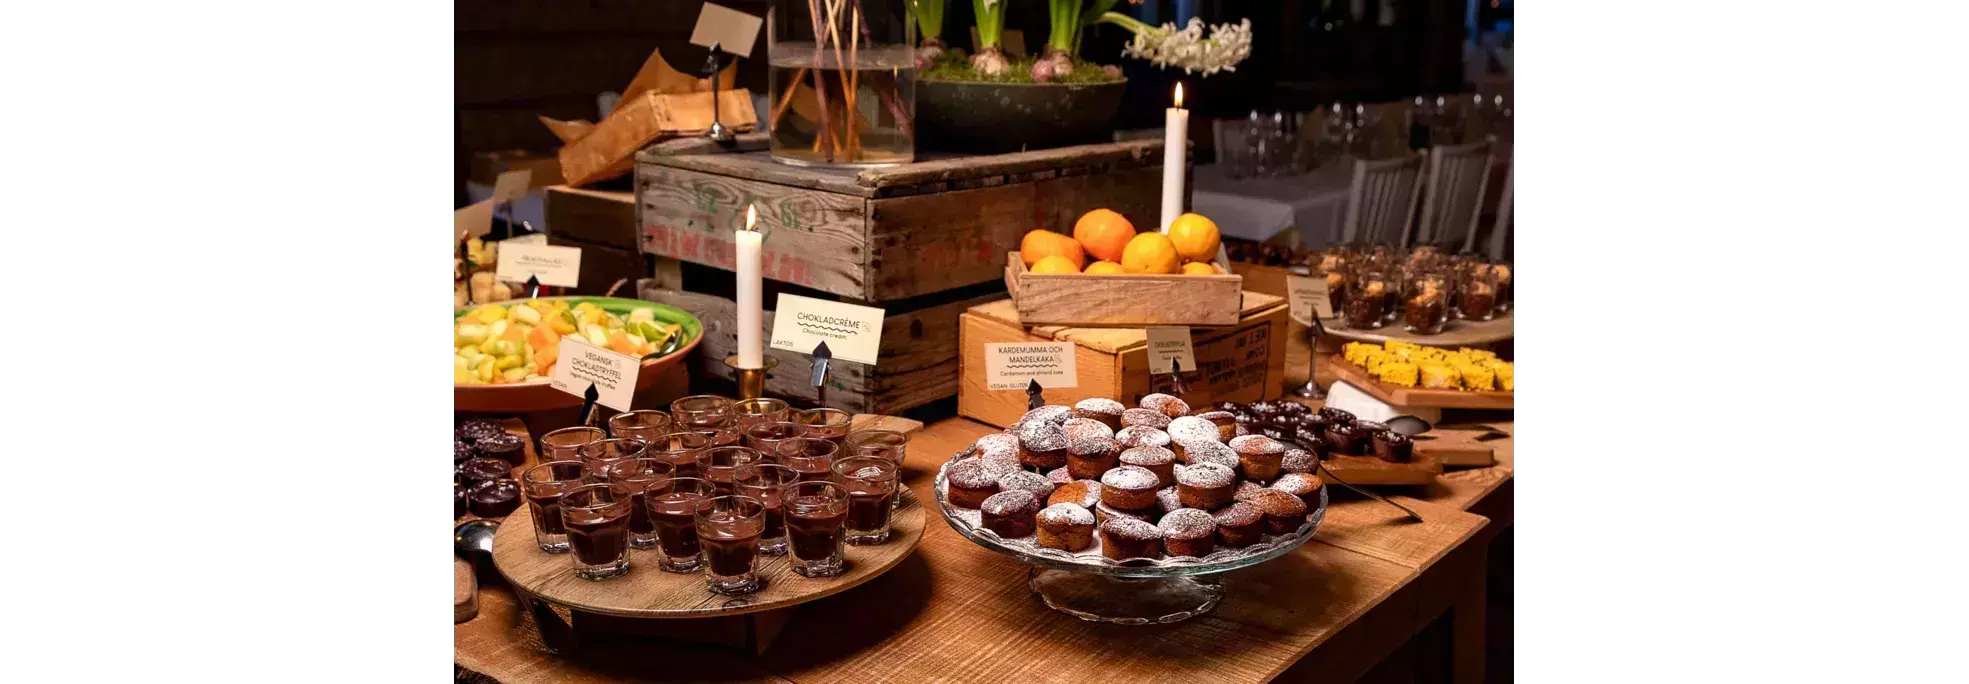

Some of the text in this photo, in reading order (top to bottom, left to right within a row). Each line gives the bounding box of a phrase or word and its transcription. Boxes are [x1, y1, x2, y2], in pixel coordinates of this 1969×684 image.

[773, 340, 794, 348] LAKTOS
[585, 351, 613, 367] VEGANSK
[572, 357, 621, 380] CHOKLADTRYFFEL
